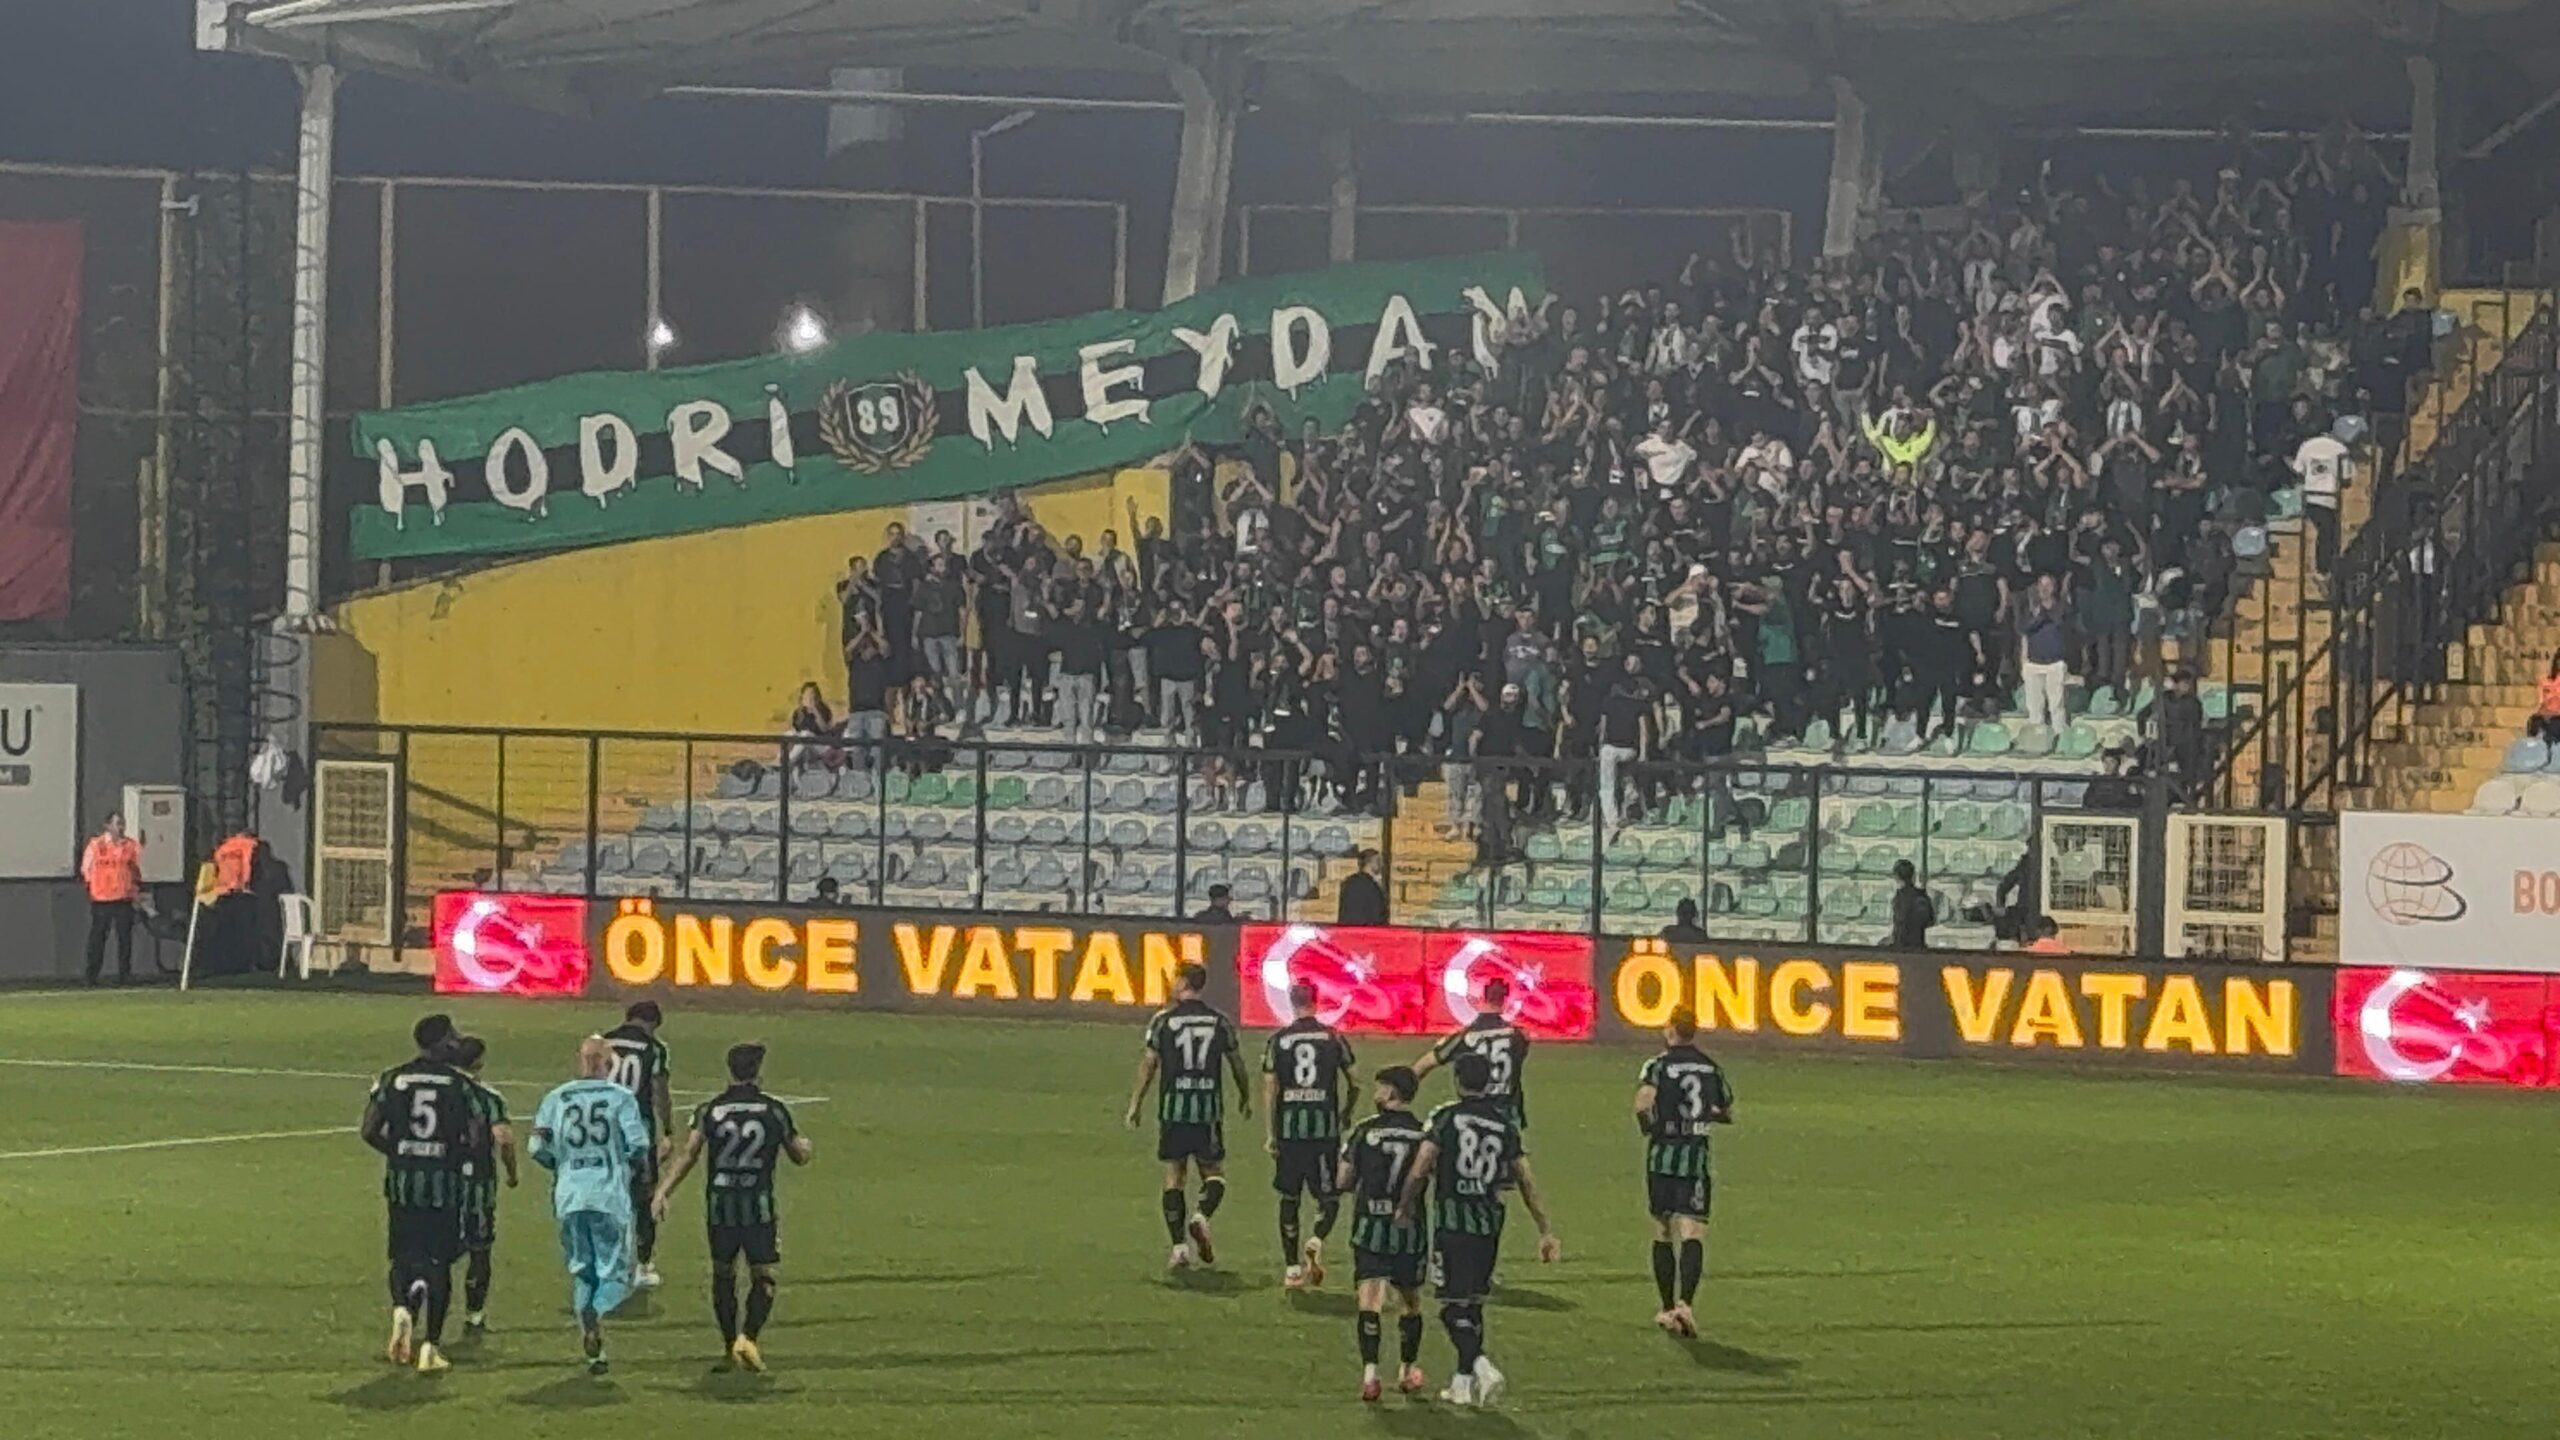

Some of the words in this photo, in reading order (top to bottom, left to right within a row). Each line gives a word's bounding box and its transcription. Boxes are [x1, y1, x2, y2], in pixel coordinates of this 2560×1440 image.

[857, 395, 900, 434] 89
[605, 897, 859, 993] ÖNCE
[893, 923, 1203, 1006] VATAN
[1615, 938, 1901, 1041] ÖNCE
[1941, 966, 2294, 1056] VATAN
[1175, 1026, 1216, 1070] 17
[1294, 1042, 1317, 1087] 8
[409, 1088, 438, 1139] 5
[1678, 1074, 1702, 1119] 3
[564, 1100, 610, 1149] 35
[716, 1119, 766, 1169] 22
[1382, 1141, 1410, 1194] 7
